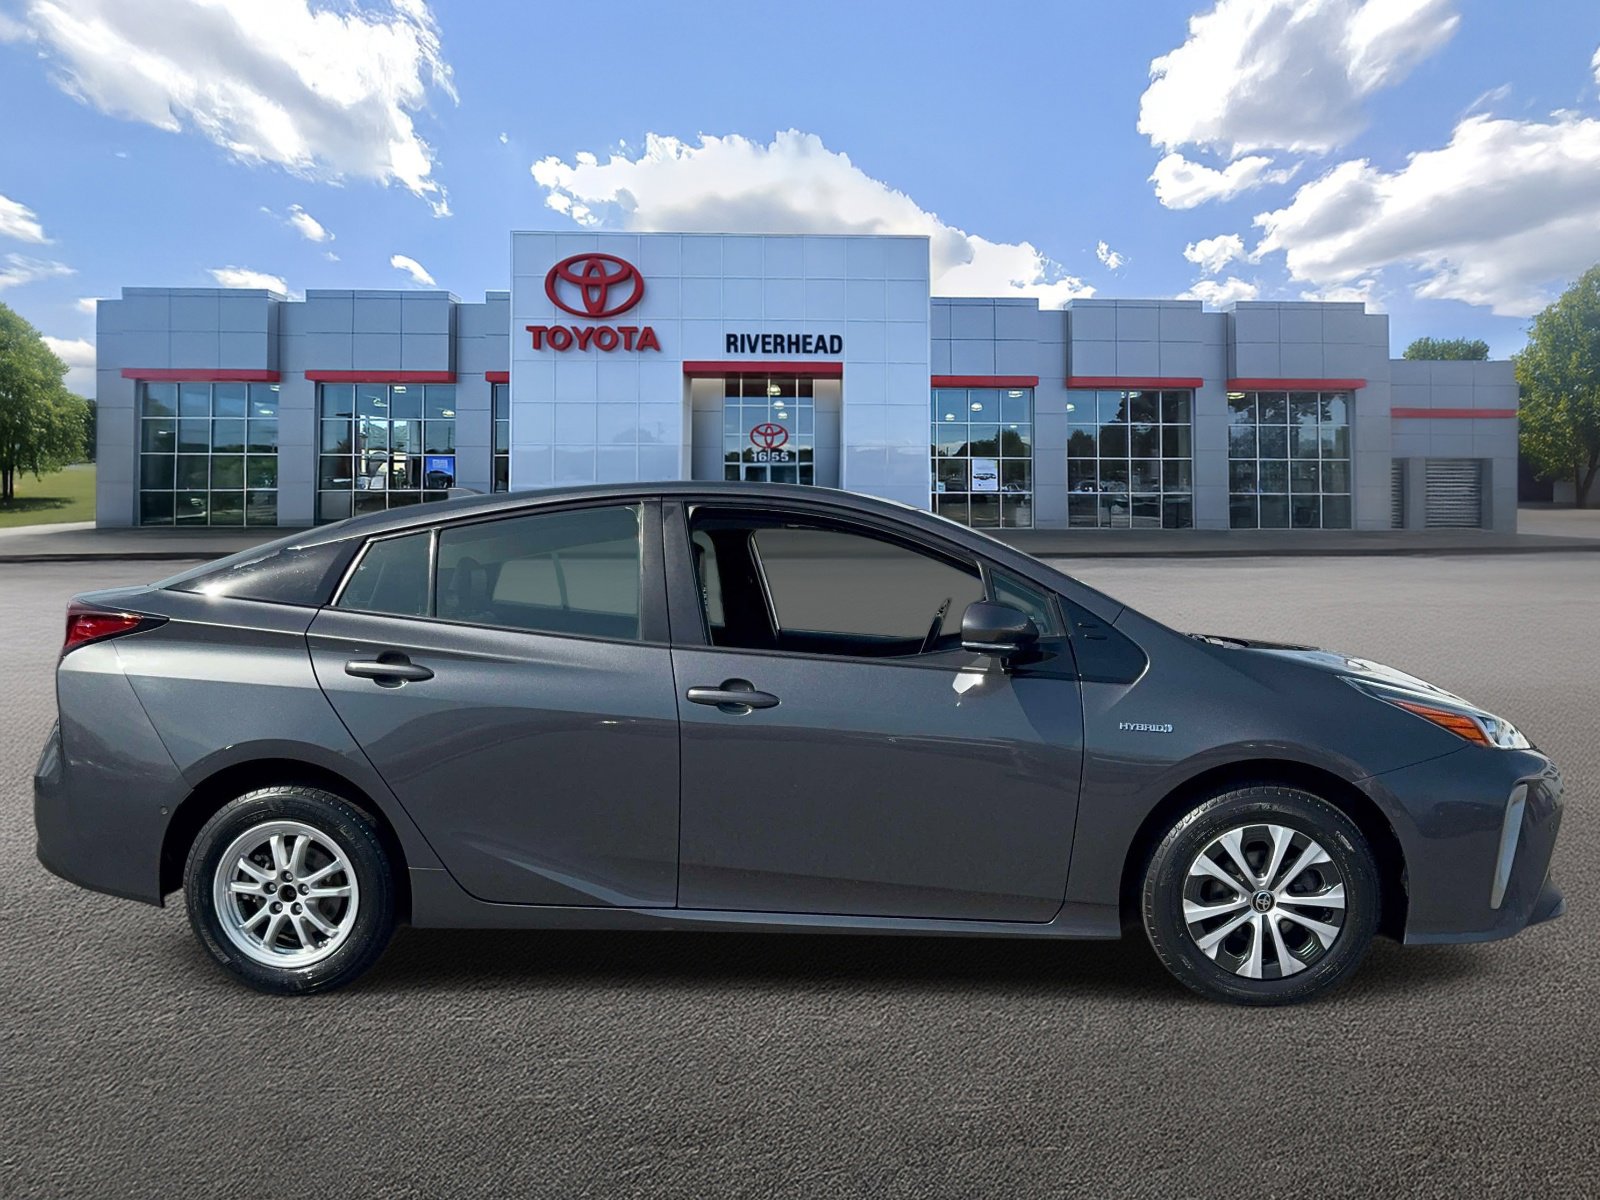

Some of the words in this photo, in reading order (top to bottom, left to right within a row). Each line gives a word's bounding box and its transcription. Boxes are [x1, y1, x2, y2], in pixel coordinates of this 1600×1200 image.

[525, 325, 661, 352] TOYOTA
[726, 333, 843, 354] RIVERHEAD
[752, 452, 789, 462] 1655
[1119, 722, 1165, 732] HYBRID
